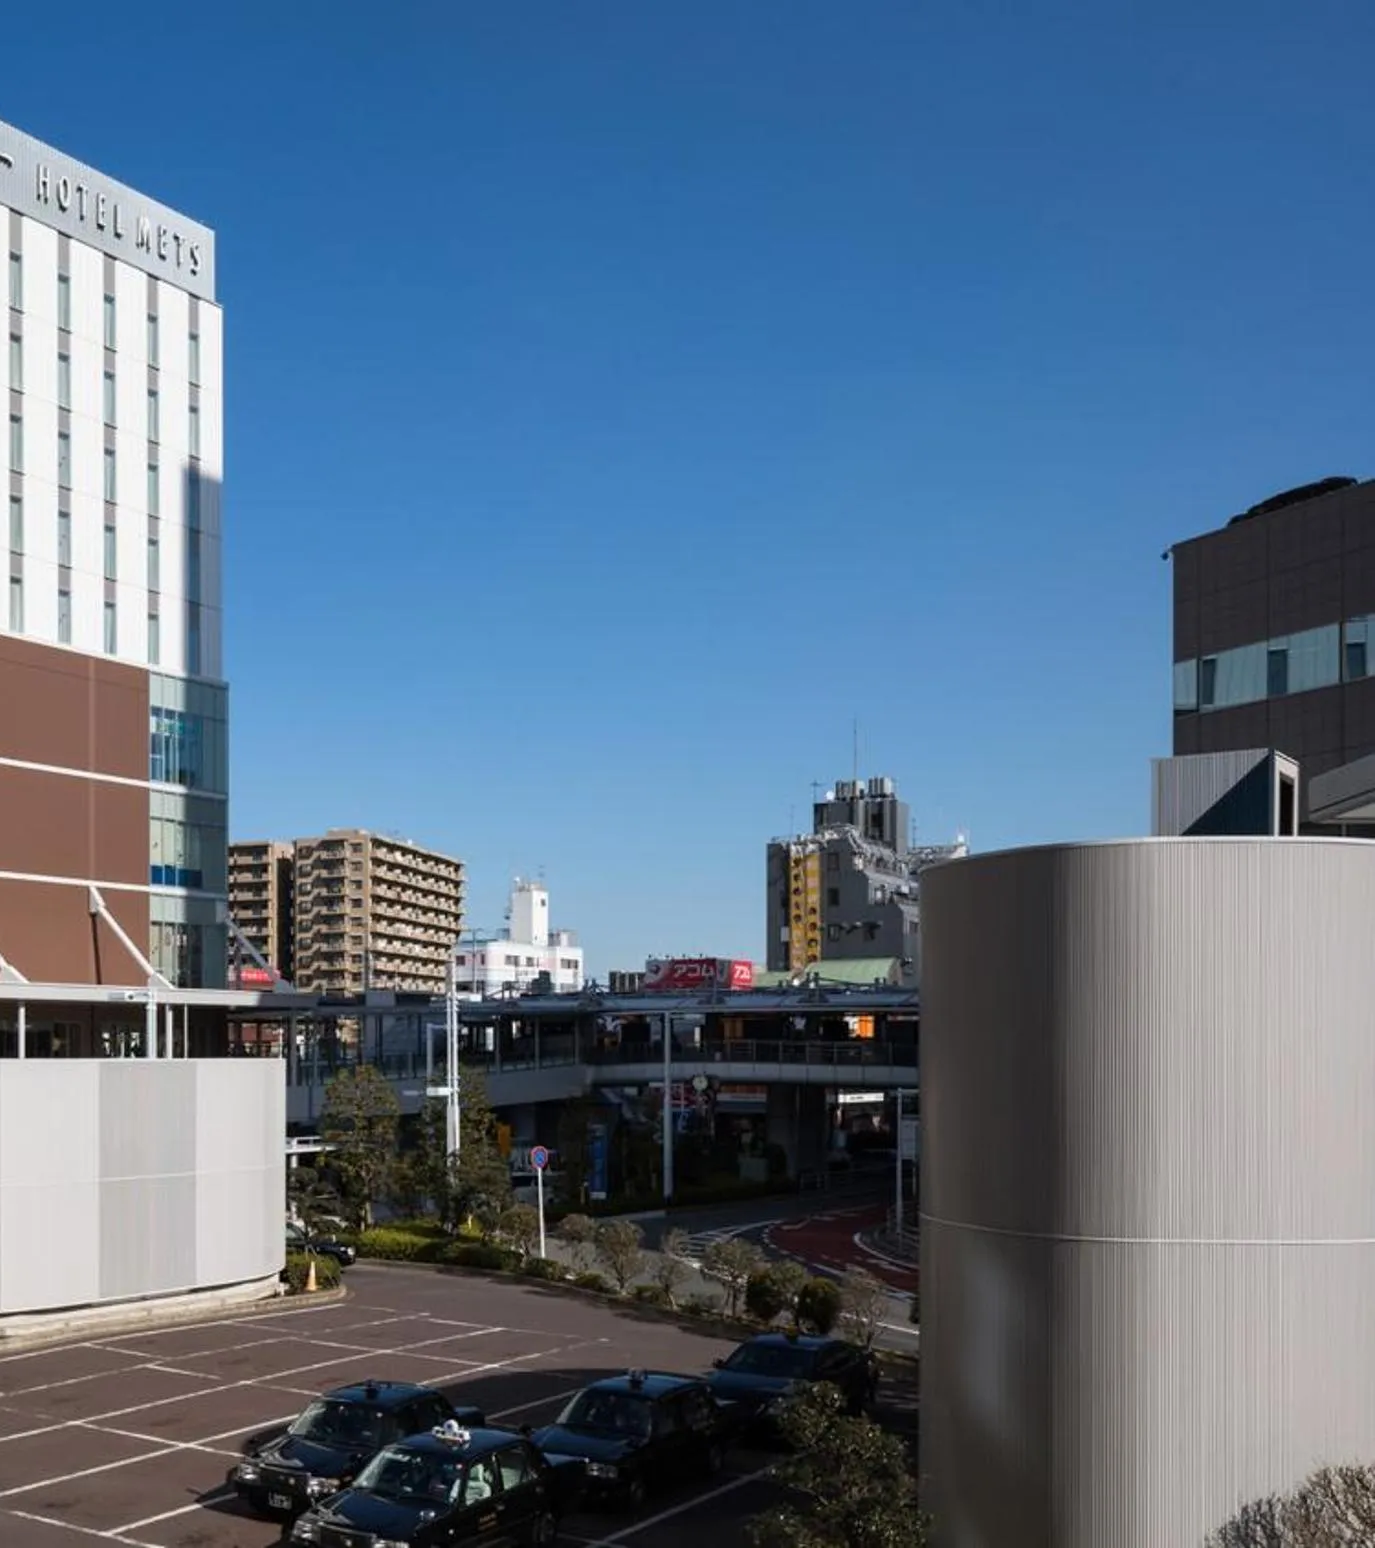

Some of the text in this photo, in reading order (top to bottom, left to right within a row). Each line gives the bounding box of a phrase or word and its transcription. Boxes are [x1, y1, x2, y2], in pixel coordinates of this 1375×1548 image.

[35, 163, 123, 240] HOTEL
[135, 209, 200, 275] METS
[673, 963, 714, 978] アコム
